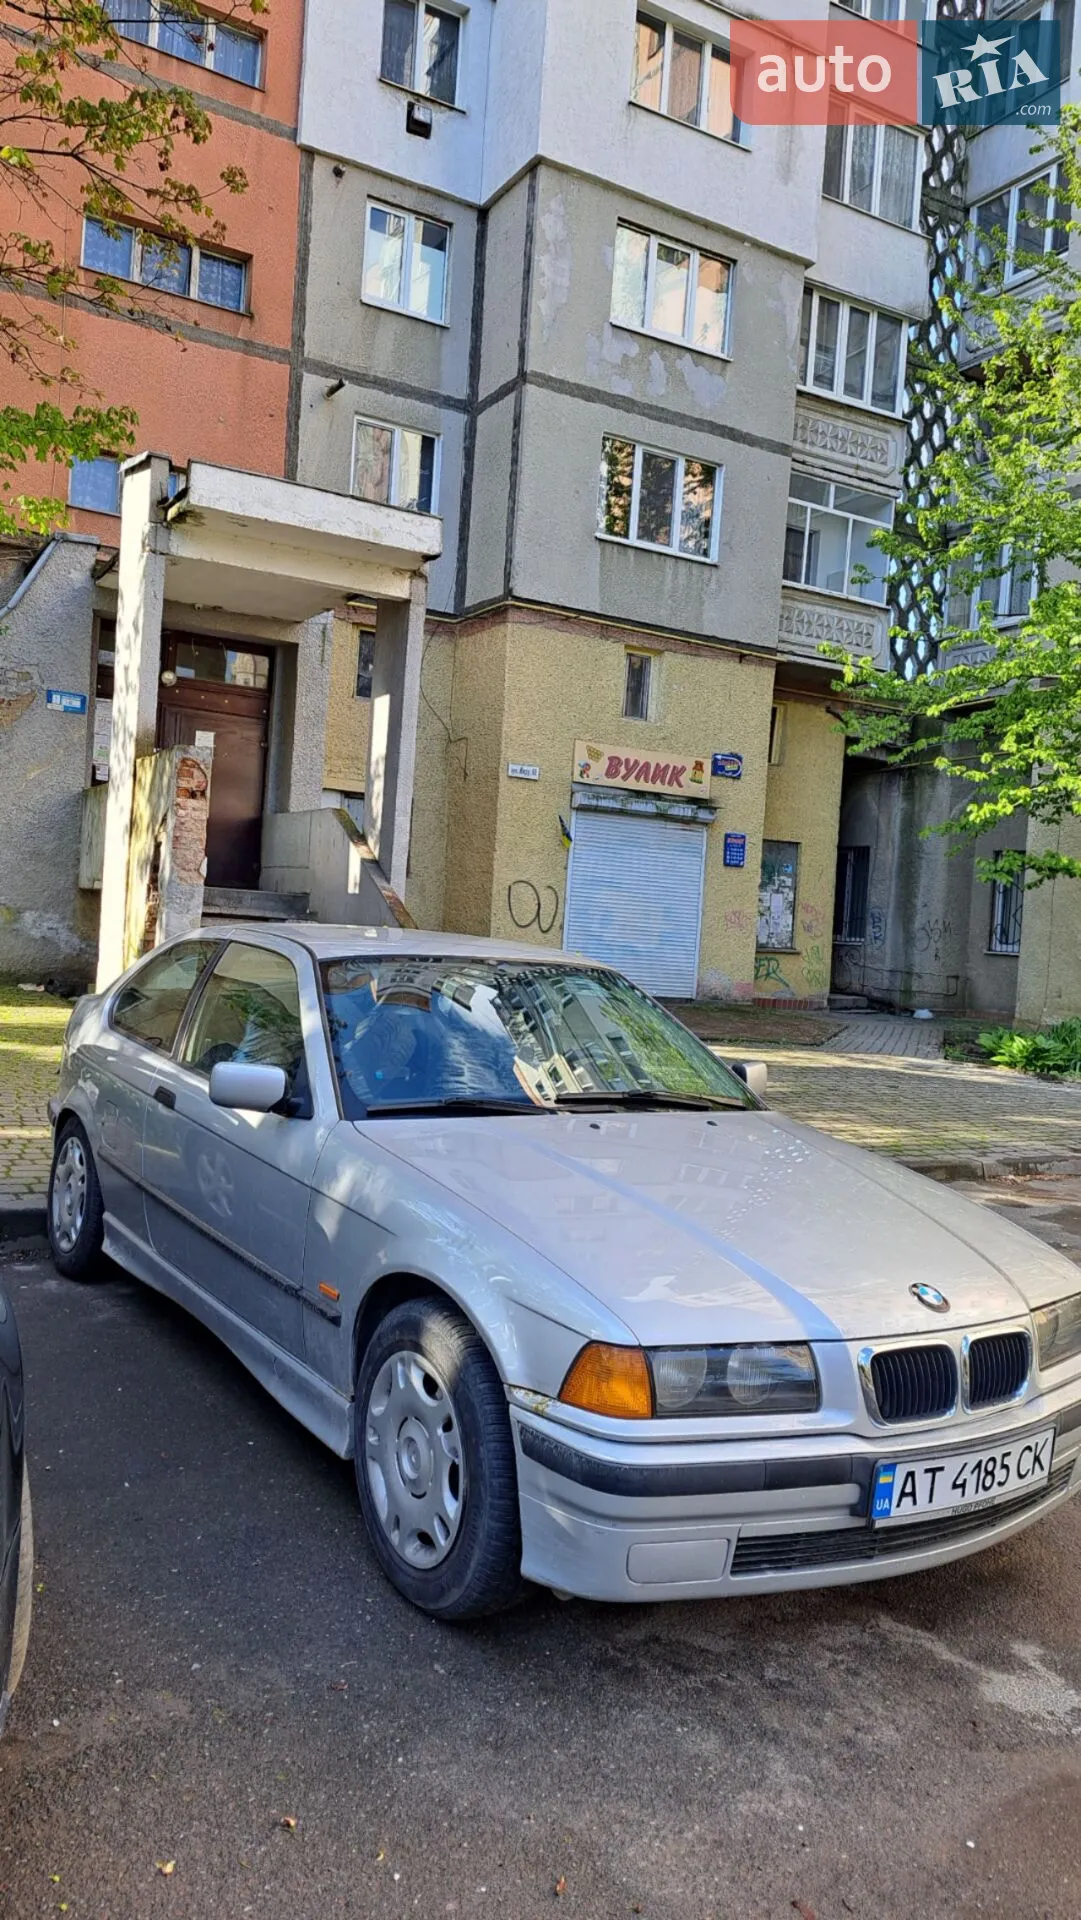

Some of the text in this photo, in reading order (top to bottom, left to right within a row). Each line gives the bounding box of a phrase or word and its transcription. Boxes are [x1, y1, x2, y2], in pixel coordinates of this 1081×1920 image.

[604, 755, 687, 788] ВУЛИК
[875, 1437, 1049, 1511] UA AT 4185 CK
